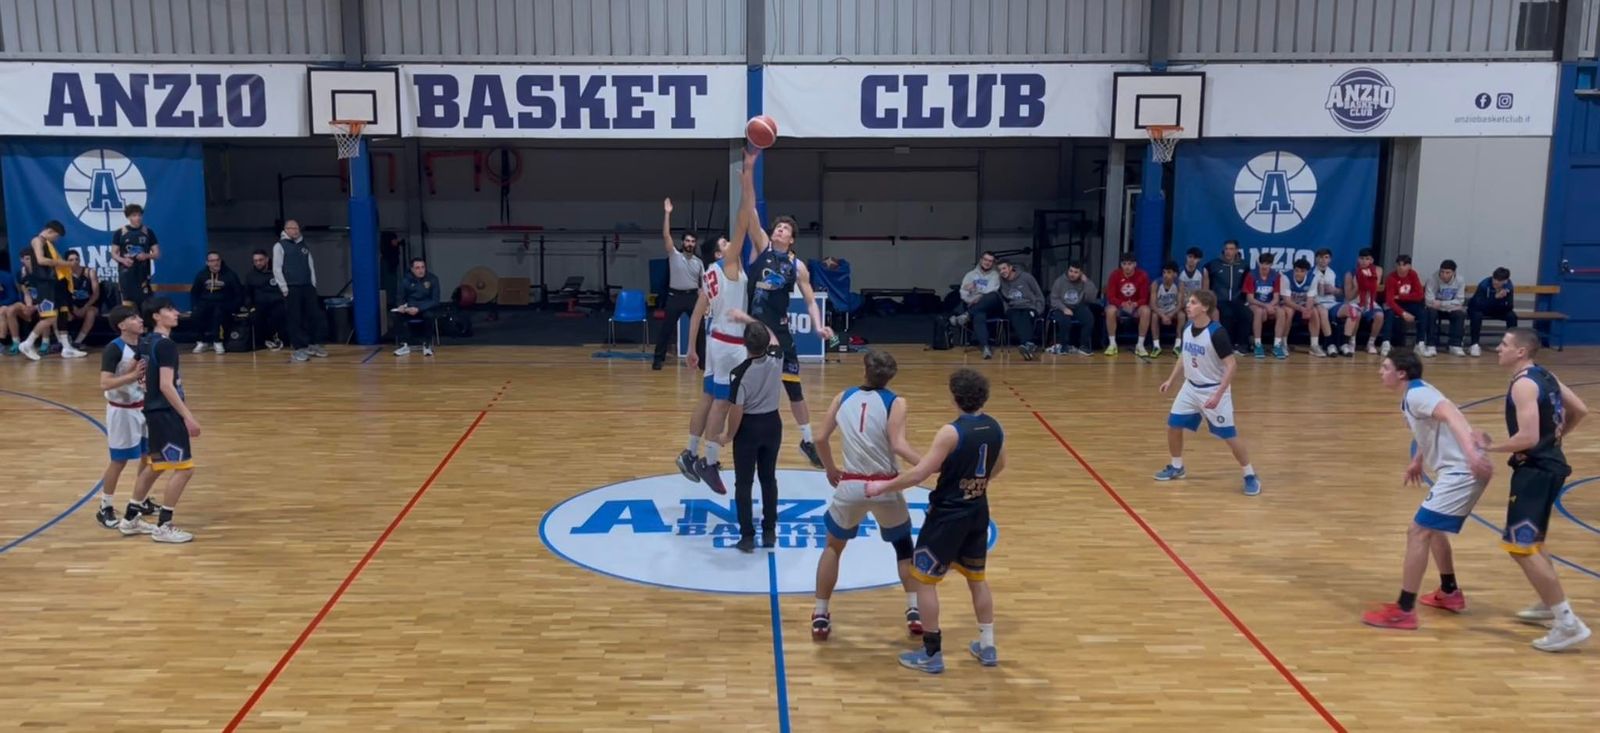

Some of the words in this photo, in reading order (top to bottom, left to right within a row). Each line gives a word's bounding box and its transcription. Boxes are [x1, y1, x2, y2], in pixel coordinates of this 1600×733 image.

[44, 72, 267, 128] ANZIO
[413, 73, 708, 129] BASKET
[860, 73, 1046, 129] CLUB
[1325, 84, 1395, 109] ANZIO
[87, 169, 126, 212] A
[1255, 170, 1294, 214] A
[1239, 247, 1315, 270] NZIO
[1191, 357, 1199, 369] 5
[860, 402, 868, 433] 1
[975, 443, 988, 478] 1
[569, 499, 931, 535] ANZ
